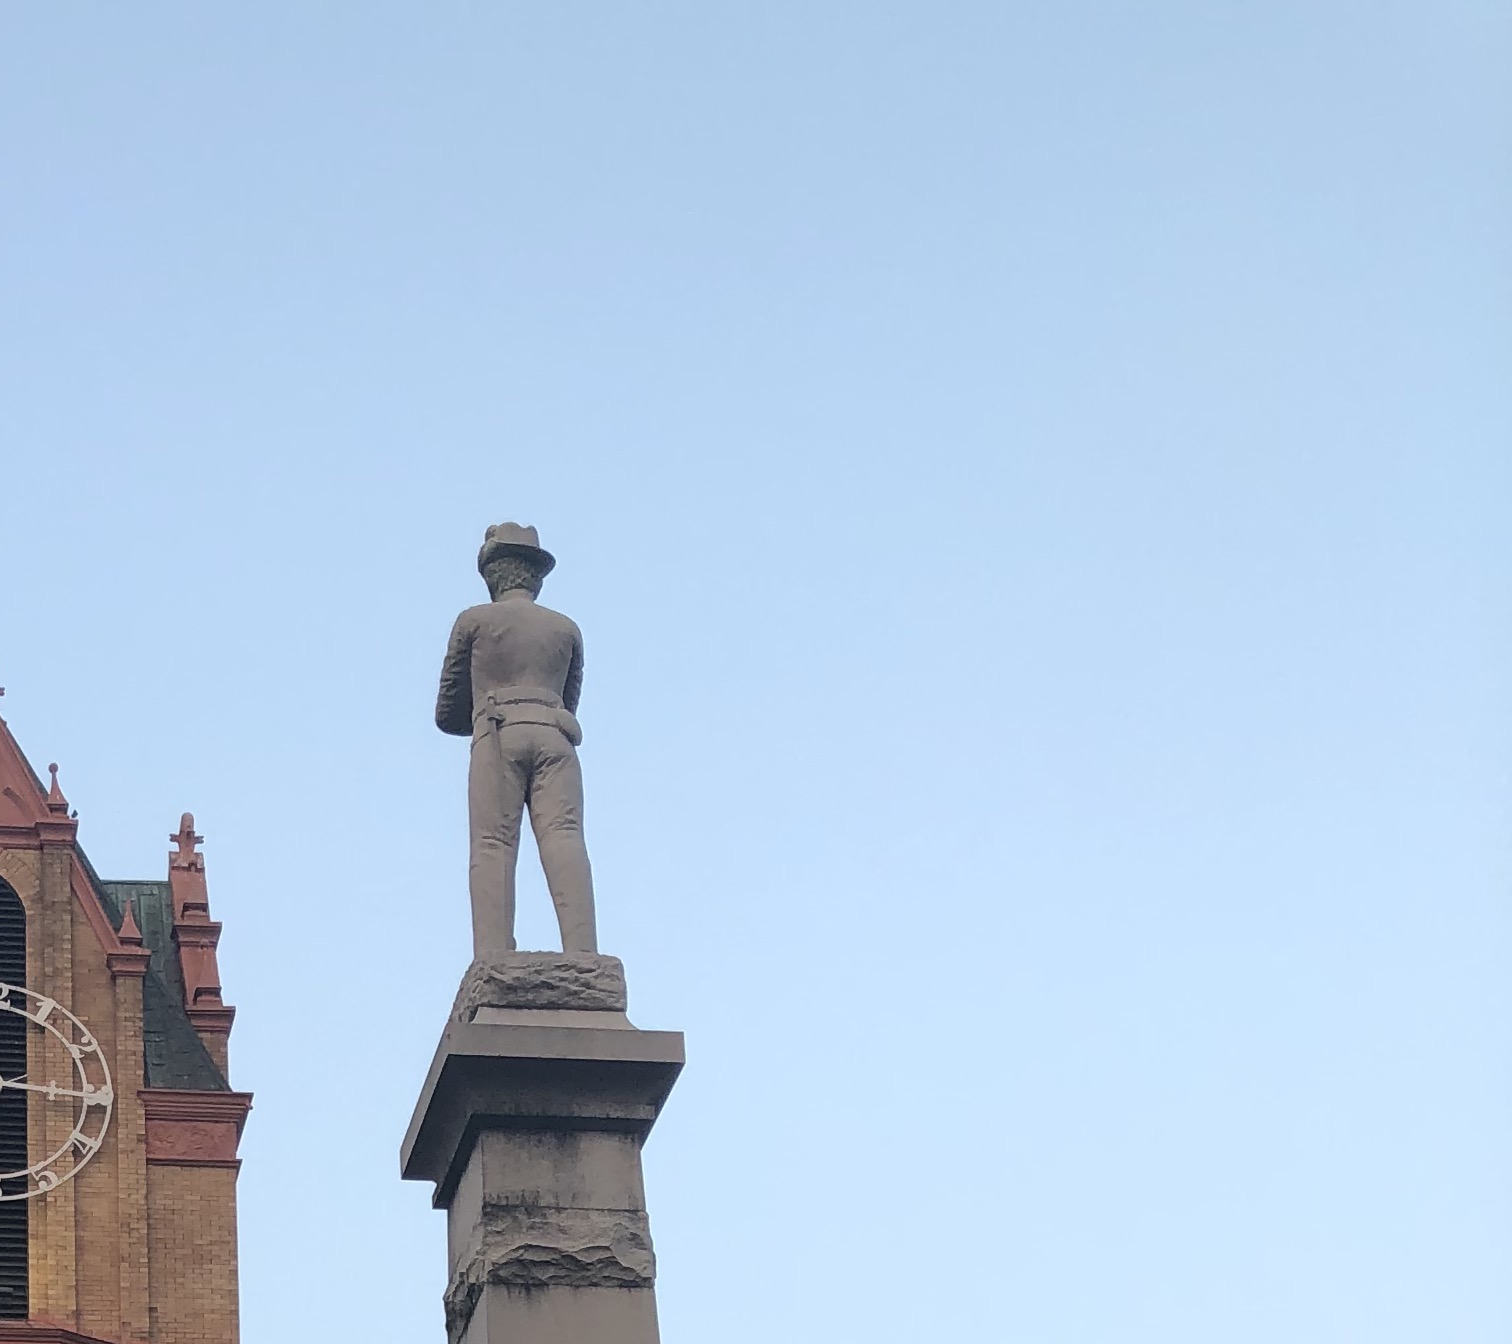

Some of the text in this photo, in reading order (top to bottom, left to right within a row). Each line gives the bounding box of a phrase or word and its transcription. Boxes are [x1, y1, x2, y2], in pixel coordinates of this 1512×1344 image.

[36, 998, 57, 1025] 1
[68, 1034, 98, 1059] 2
[69, 1129, 101, 1154] 4
[30, 1161, 60, 1191] 5
